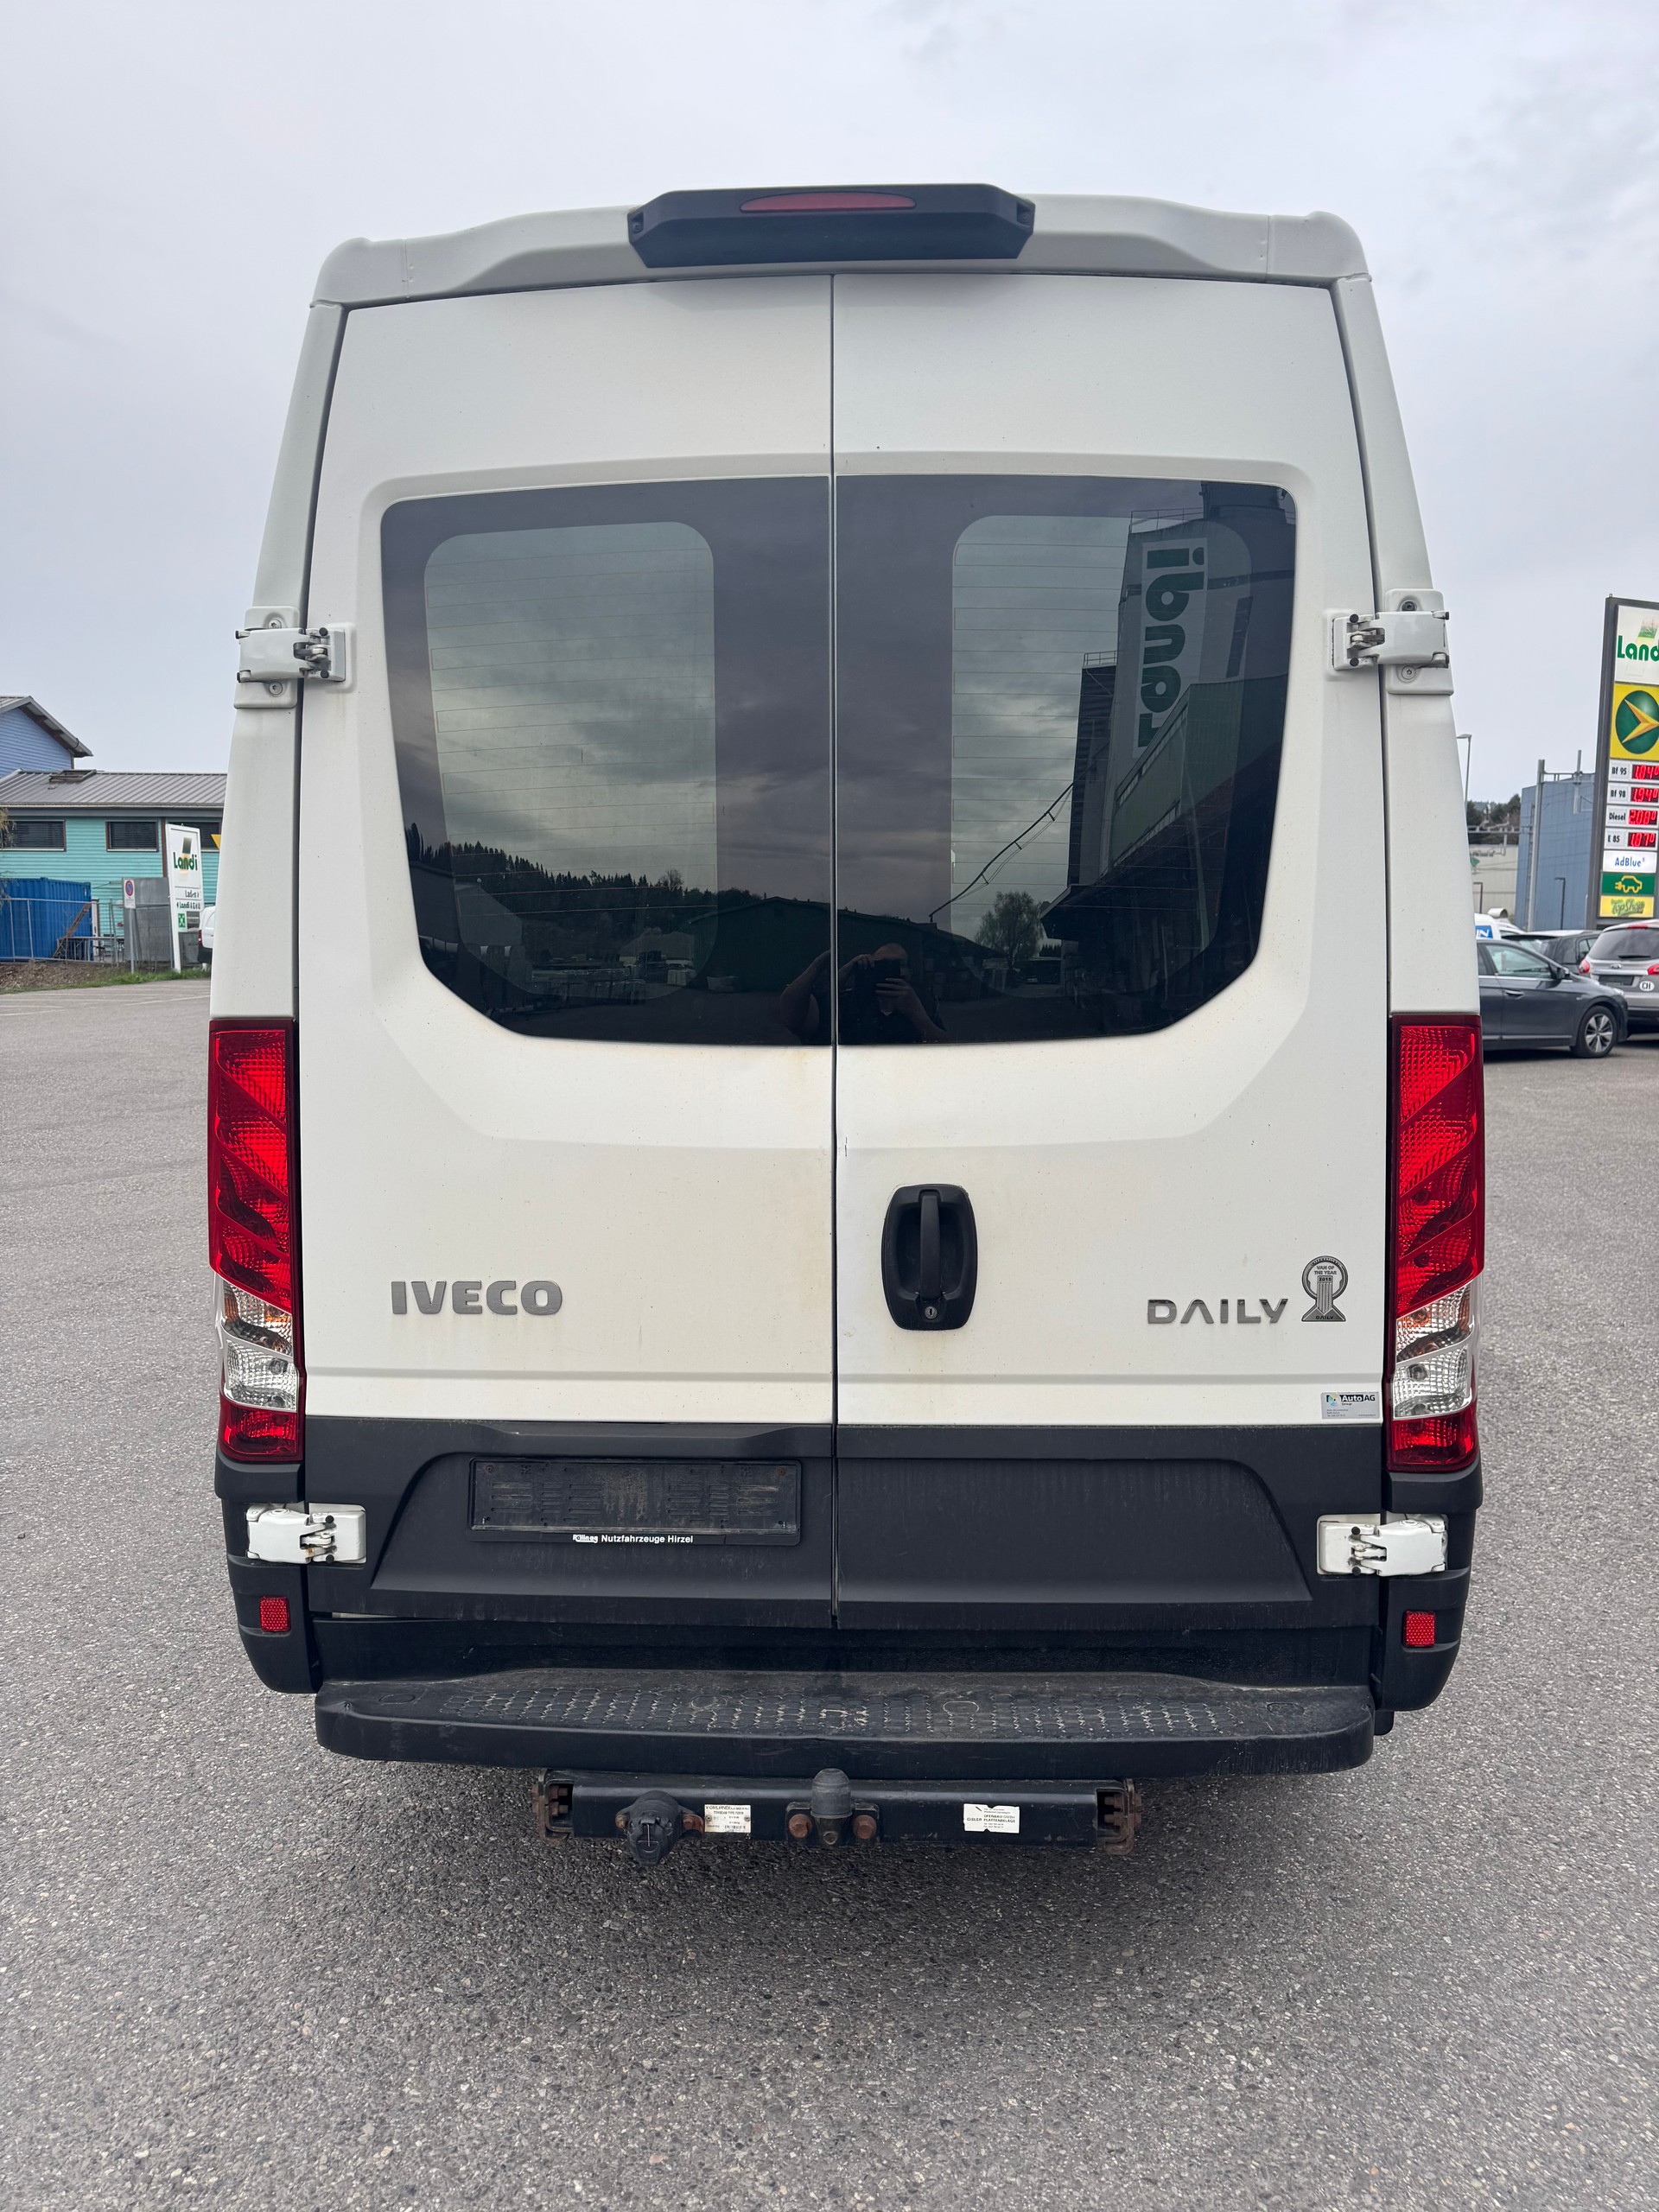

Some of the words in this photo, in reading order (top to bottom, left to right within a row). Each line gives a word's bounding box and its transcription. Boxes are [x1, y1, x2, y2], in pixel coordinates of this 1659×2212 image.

[1620, 767, 1627, 776] 95
[1618, 790, 1626, 798] 98
[1612, 835, 1620, 843] 85
[173, 851, 198, 871] Landi
[391, 1280, 563, 1315] IVECO
[1147, 1298, 1288, 1325] DAILY
[601, 1534, 665, 1544] Nutzfahrzeuge
[667, 1535, 694, 1543] Hirzel
